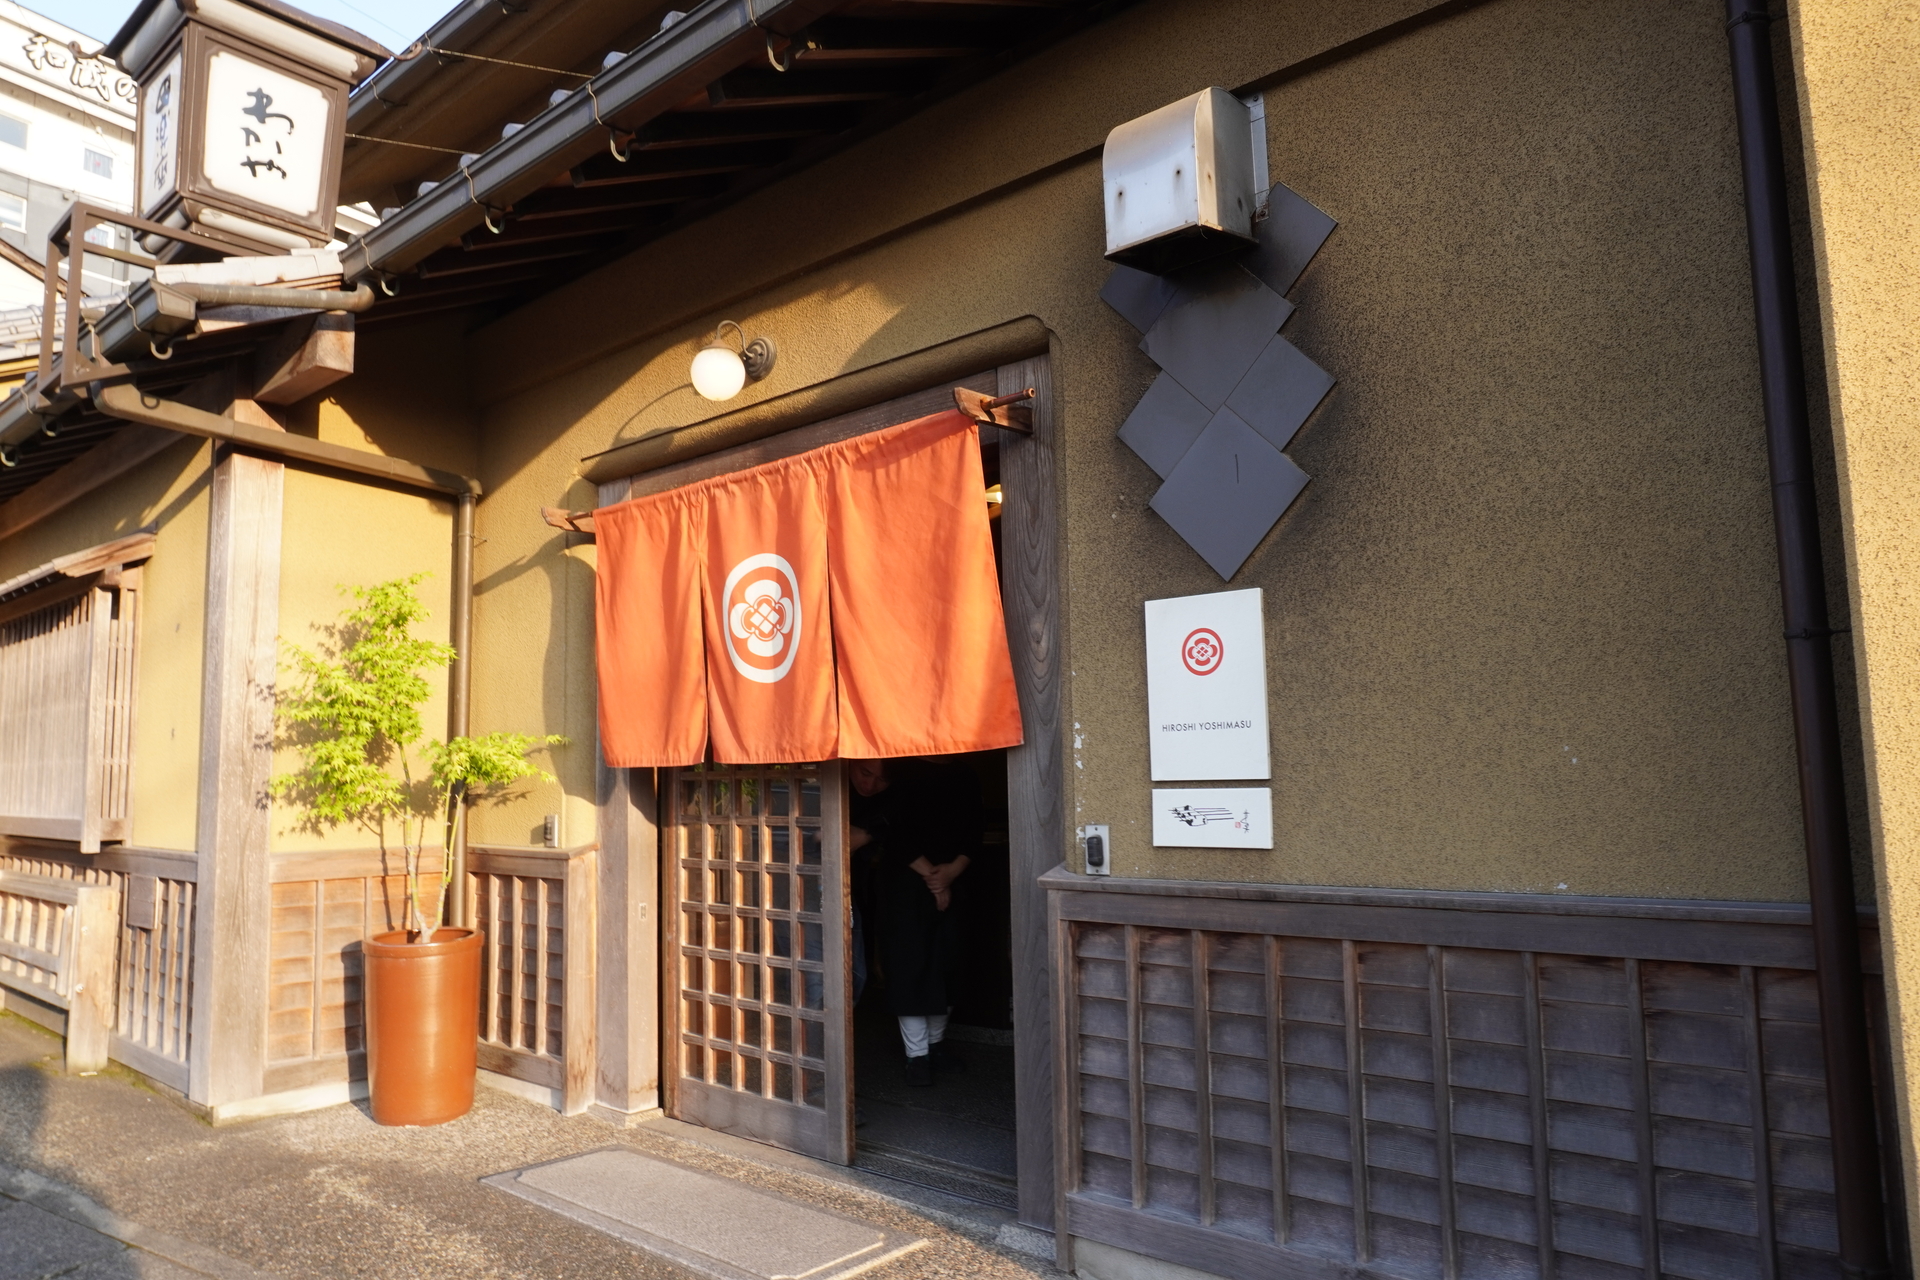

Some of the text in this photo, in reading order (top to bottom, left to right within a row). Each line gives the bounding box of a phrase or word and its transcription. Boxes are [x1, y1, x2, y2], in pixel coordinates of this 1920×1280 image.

[240, 87, 294, 179] わかや
[1162, 720, 1252, 732] HIROSHI YOSHIMASU
